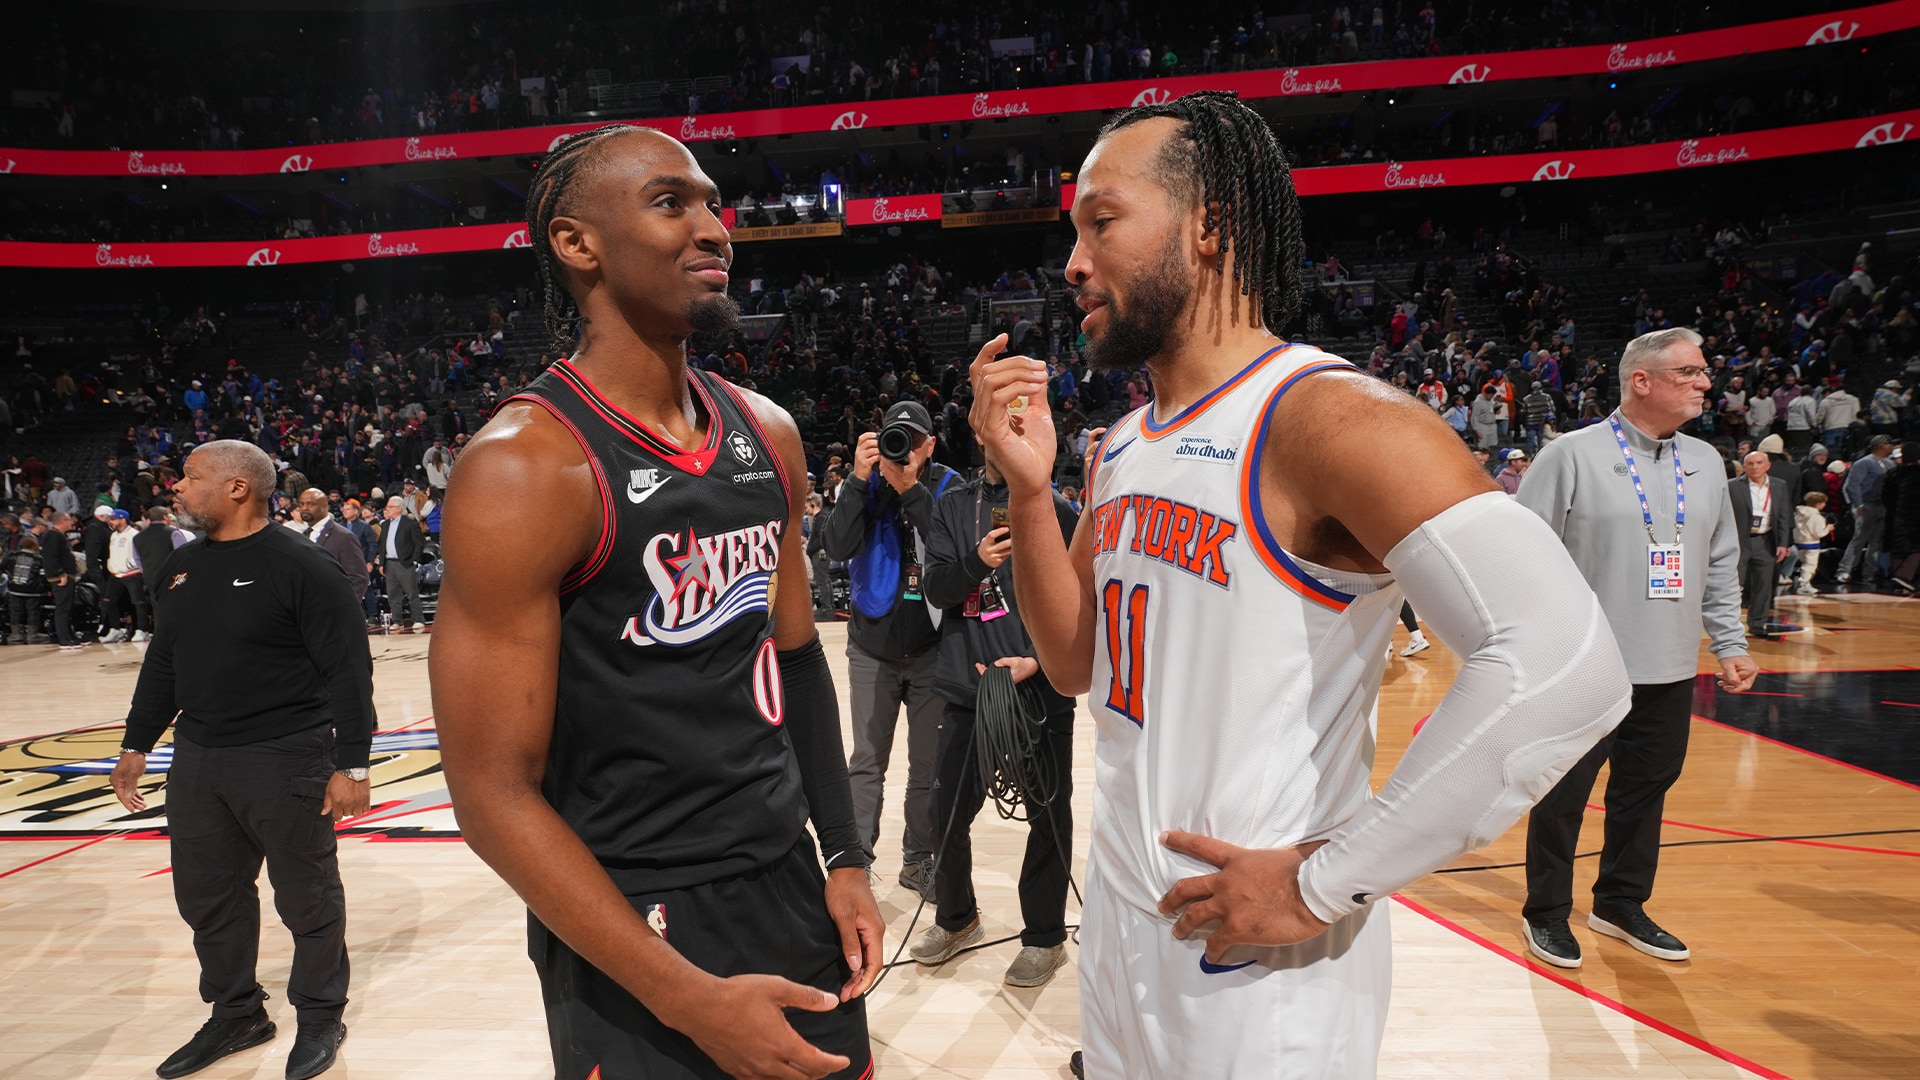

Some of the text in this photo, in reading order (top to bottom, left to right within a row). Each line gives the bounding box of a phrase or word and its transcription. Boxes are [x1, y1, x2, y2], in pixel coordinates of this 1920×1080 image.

[1607, 43, 1676, 71] Chick-fil-A
[1281, 68, 1341, 95] Chick-fil-A
[972, 92, 1030, 118] Chick-fil-A
[680, 116, 735, 141] Chick-fil-A
[405, 137, 457, 161] Chick-fil-A
[1677, 139, 1749, 166] Chick-fil-A
[128, 151, 185, 176] Chick-fil-A
[1384, 160, 1446, 188] Chick-fil-A
[872, 197, 929, 222] Chick-fil-A
[368, 232, 419, 257] Chick-fil-A
[752, 230, 769, 239] EVERY
[770, 229, 780, 237] DAY
[789, 227, 804, 235] GAME
[806, 226, 816, 234] DAY
[96, 243, 154, 268] Chick-fil-A
[1176, 444, 1238, 460] abu dhabi
[1181, 436, 1212, 444] experience
[630, 468, 658, 488] NIKE
[733, 470, 775, 484] crypto.com
[1130, 494, 1238, 589] YORK
[1103, 578, 1149, 730] 11
[753, 637, 784, 726] 0
